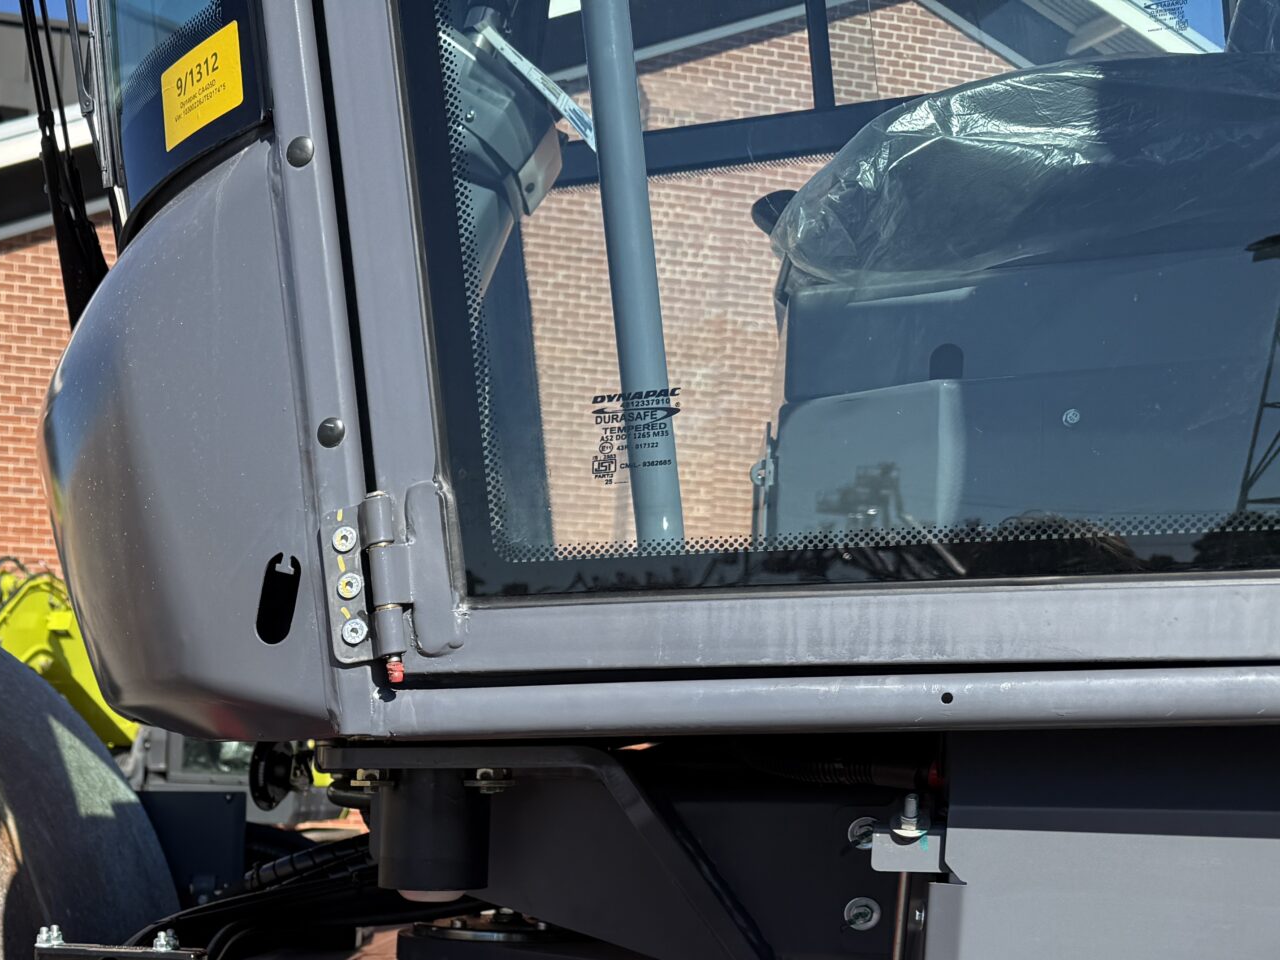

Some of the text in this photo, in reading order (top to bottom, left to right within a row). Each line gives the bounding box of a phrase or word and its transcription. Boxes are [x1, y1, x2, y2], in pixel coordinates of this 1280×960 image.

[176, 52, 219, 97] 9/1312
[592, 387, 681, 404] DYNAPAC
[595, 410, 658, 424] DURASAFE
[602, 422, 667, 434] TEMPERED
